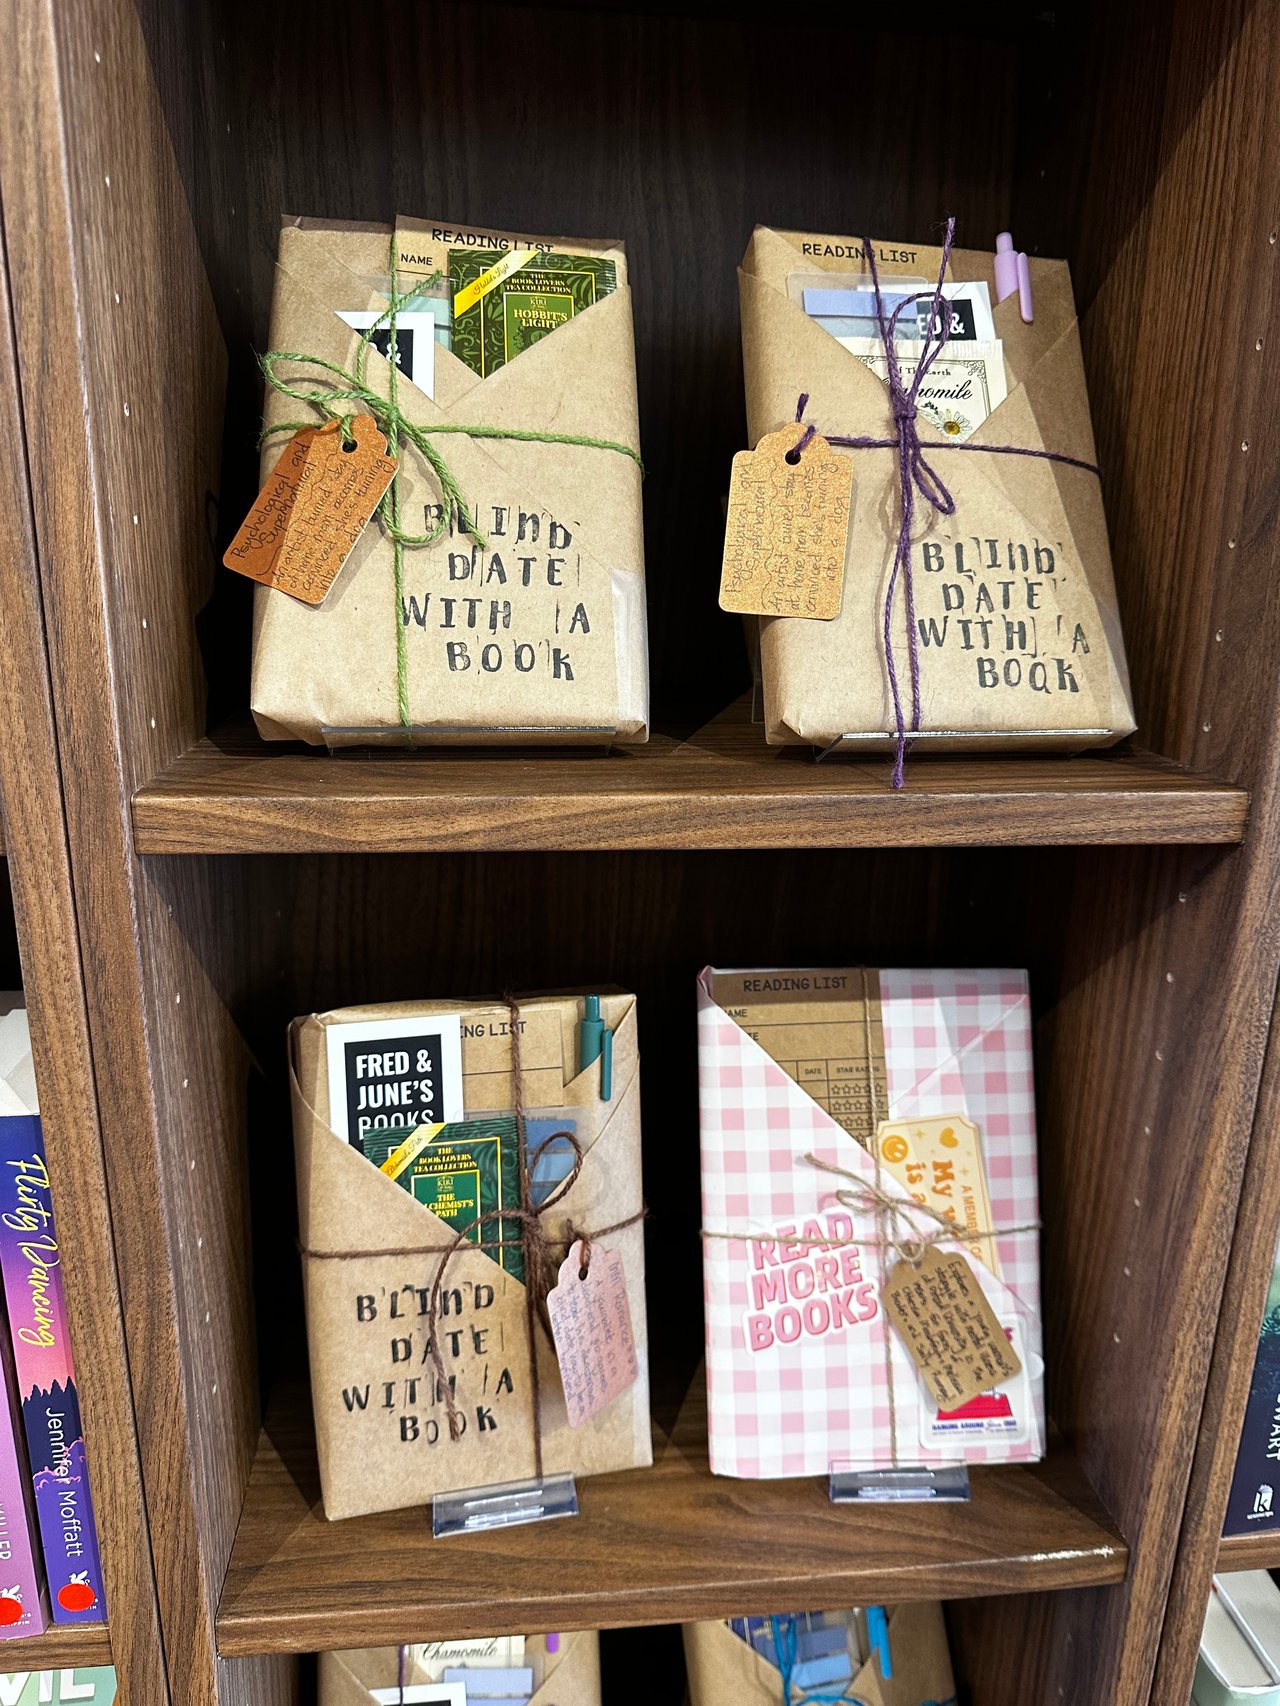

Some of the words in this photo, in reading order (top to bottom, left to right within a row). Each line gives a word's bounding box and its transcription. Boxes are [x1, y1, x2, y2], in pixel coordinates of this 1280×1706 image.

[432, 228, 509, 251] READING
[401, 253, 433, 266] NAME
[802, 243, 874, 260] READIN
[880, 249, 918, 264] LIST
[505, 284, 521, 292] TEA
[522, 285, 572, 294] COLLECTION
[511, 278, 534, 286] BOOK
[535, 279, 566, 287] LOVERS
[514, 309, 568, 322] HOBBIT'S
[522, 319, 559, 330] LIGHT
[780, 473, 803, 498] stay
[231, 473, 291, 559] Psychological
[291, 441, 311, 467] and
[267, 462, 317, 545] Supernatural
[829, 496, 848, 523] dog
[335, 503, 358, 531] she's
[285, 529, 304, 564] artist
[449, 553, 566, 587] DATE
[776, 553, 790, 588] artist
[942, 581, 1043, 614] DATE
[402, 592, 511, 630] WITH
[569, 603, 591, 634] A
[918, 615, 1027, 651] WITH
[1072, 623, 1090, 654] A
[446, 641, 574, 681] BOOK
[743, 977, 810, 992] READING
[814, 976, 848, 990] LIST
[728, 1008, 748, 1018] AME
[356, 1051, 410, 1079] FRED
[416, 1049, 433, 1073] &
[804, 1067, 822, 1076] DATE
[357, 1079, 434, 1111] JUNE'S
[419, 1156, 441, 1165] BOOK
[442, 1153, 472, 1163] LOVERS
[437, 1147, 453, 1155] THE
[414, 1165, 428, 1173] TEA
[428, 1160, 477, 1172] COLLECTION
[905, 1162, 927, 1185] is
[931, 1160, 955, 1198] My
[2, 1154, 51, 1232] Flirty
[436, 1193, 455, 1202] THE
[961, 1185, 972, 1193] A
[425, 1199, 474, 1210] LCHEMIST'S
[435, 1208, 458, 1218] PATH
[963, 1196, 981, 1244] MEMBR
[751, 1212, 854, 1271] READ
[17, 1235, 60, 1348] Dancing
[751, 1247, 863, 1311] MORE
[582, 1288, 599, 1332] dead-end
[615, 1288, 633, 1346] Romance
[748, 1283, 878, 1352] BOOKS
[565, 1327, 574, 1348] date
[495, 1367, 514, 1394] A
[45, 1407, 73, 1484] Jennifer
[58, 1490, 84, 1558] Moffatt
[422, 1637, 498, 1661] Chamomile
